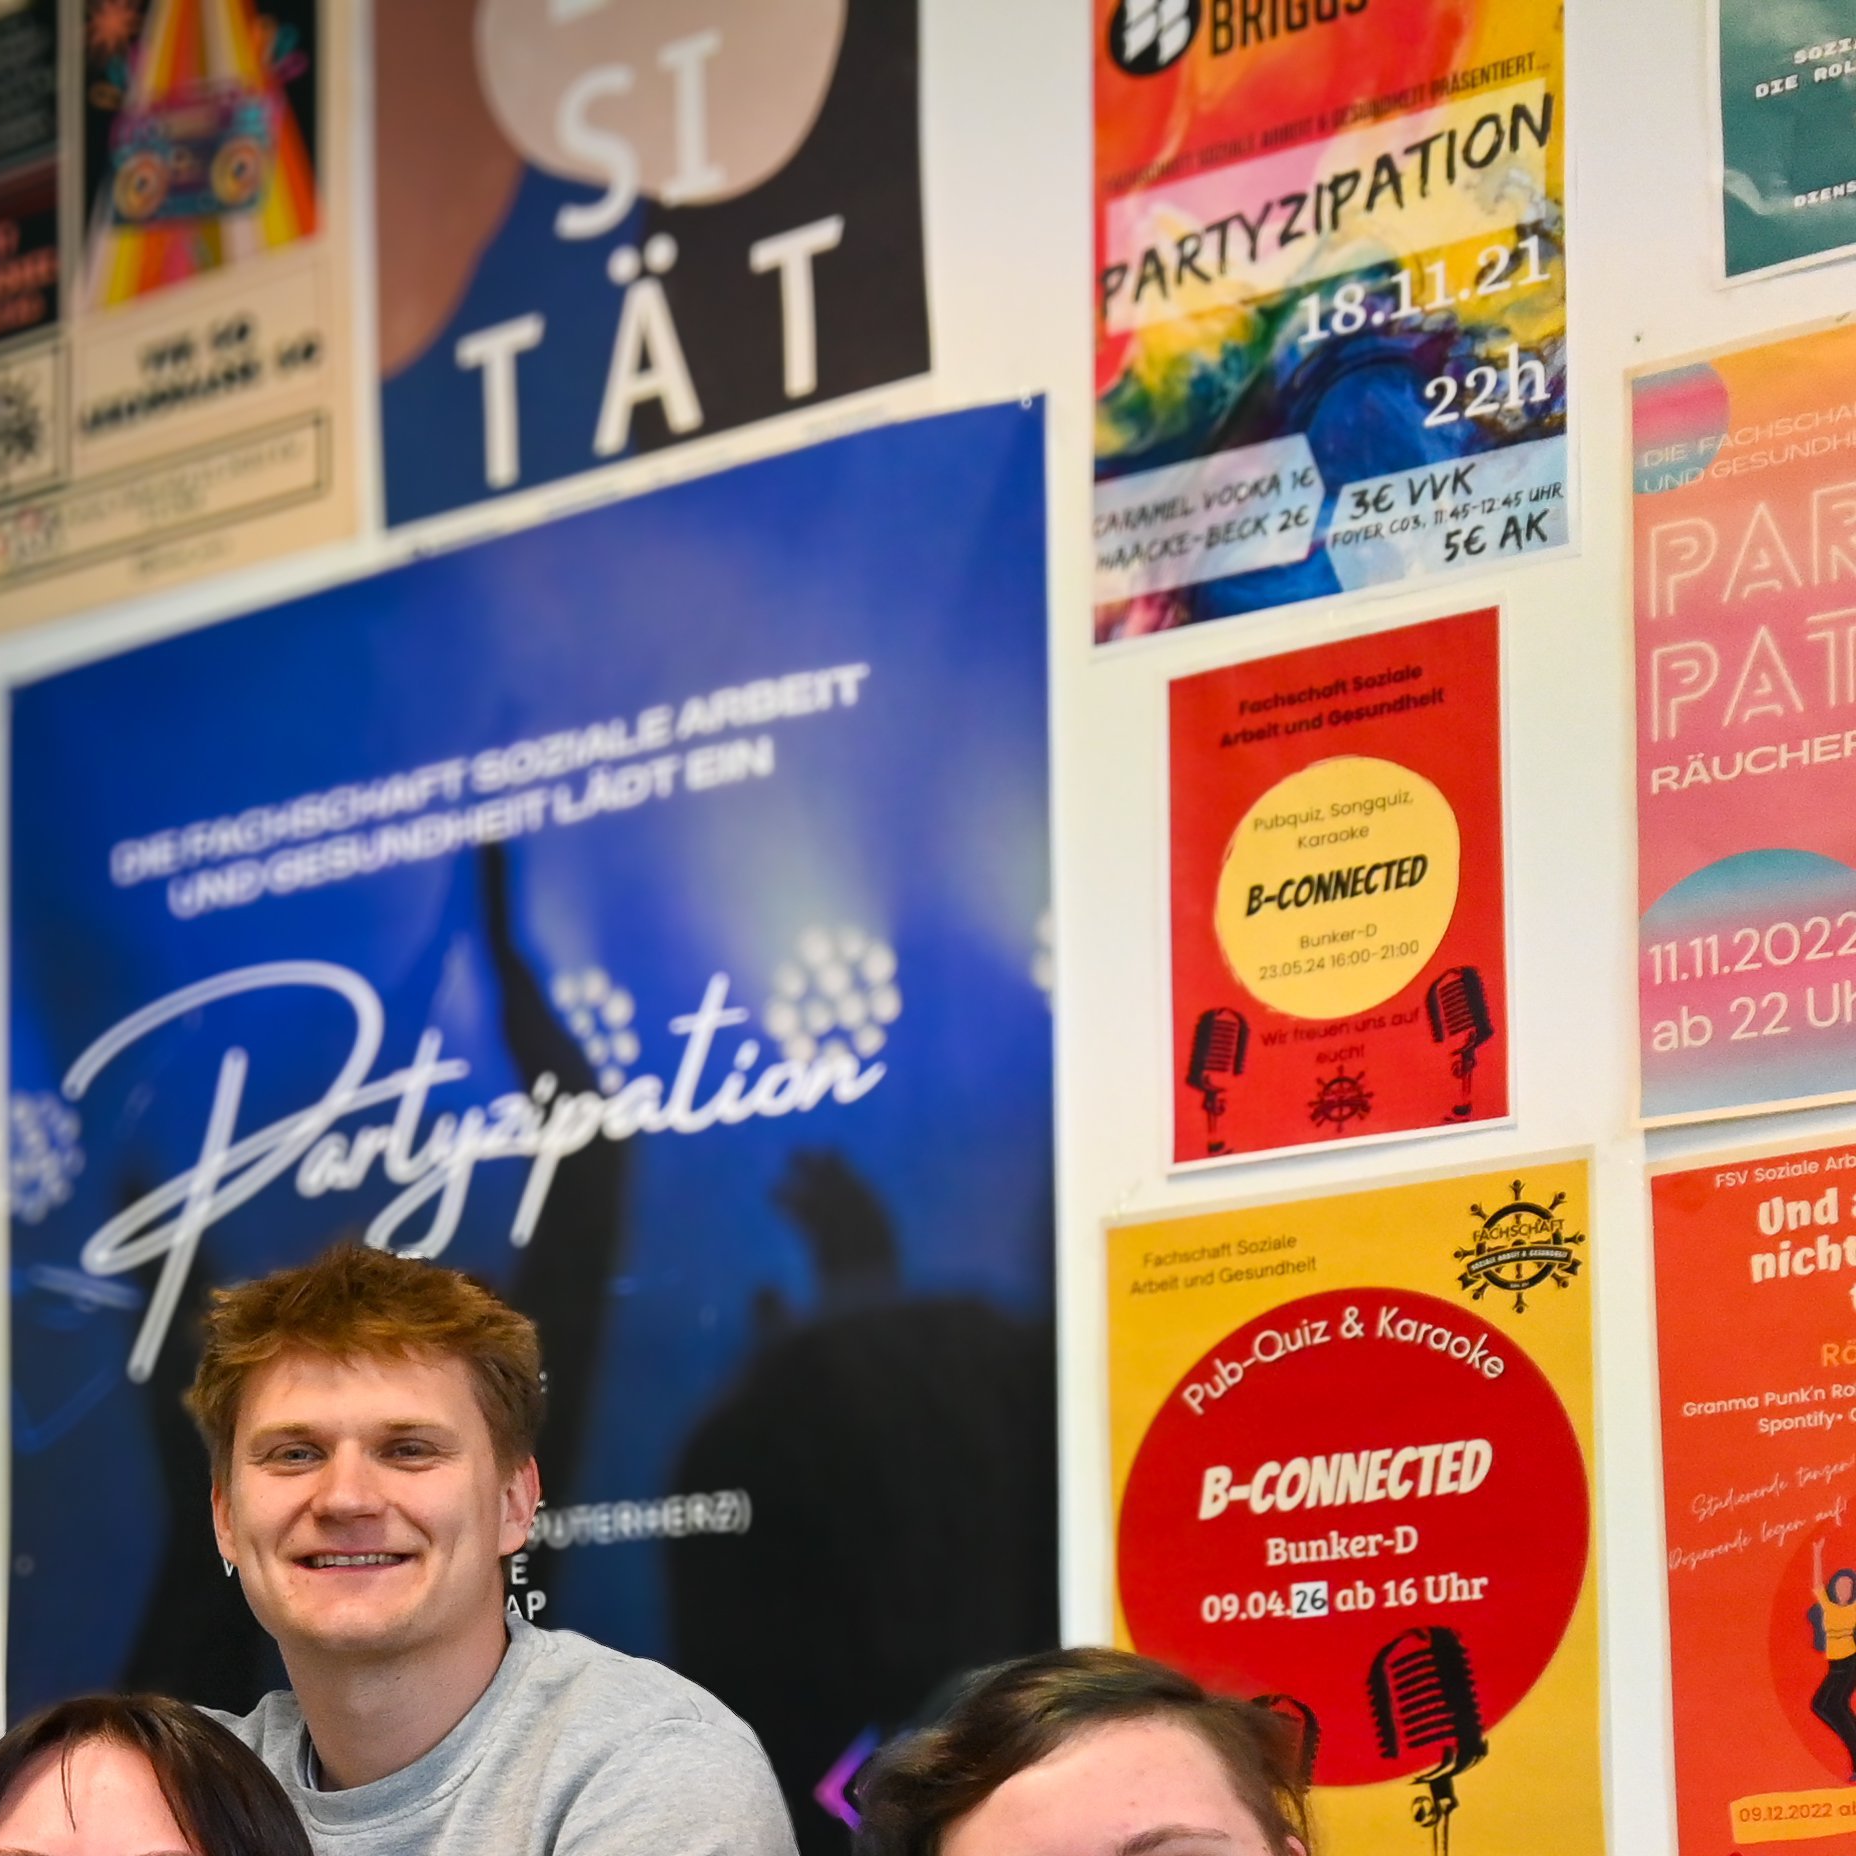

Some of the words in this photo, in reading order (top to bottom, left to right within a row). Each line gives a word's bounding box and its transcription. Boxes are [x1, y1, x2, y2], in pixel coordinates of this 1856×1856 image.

[1755, 73, 1800, 100] DIE
[1097, 90, 1558, 316] PARTYZIPATION
[1297, 233, 1551, 347] 18.11.21
[454, 213, 845, 491] TÄT
[1421, 341, 1552, 431] 22h
[1642, 441, 1690, 469] DIE
[1698, 401, 1856, 454] FACHSCHA
[1643, 465, 1706, 494] UND
[1710, 428, 1856, 480] GESUNDH
[1090, 495, 1195, 541] CARAMEL
[1201, 472, 1282, 513] VODKA
[1289, 464, 1316, 493] 1€
[1330, 522, 1386, 551] FOYER
[1527, 480, 1566, 505] UHR
[1348, 482, 1397, 521] 3€
[1406, 461, 1478, 508] VVK
[1277, 504, 1311, 533] 2€
[1442, 527, 1488, 564] 5€
[1499, 508, 1551, 551] AK
[1238, 678, 1349, 717] Fachschaft
[1351, 664, 1424, 693] Soziale
[1219, 722, 1281, 749] Arbeit
[1283, 712, 1325, 737] und
[1327, 686, 1446, 728] Gesundheit
[108, 826, 184, 888] DIE
[180, 755, 470, 864] FACHSCHAFT
[469, 702, 675, 794] SOZIALE
[675, 661, 872, 742] ARBEIT
[166, 857, 267, 921] UND
[261, 786, 550, 895] GESUNDHEIT
[551, 753, 683, 827] LÄDT
[682, 732, 776, 793] EIN
[1329, 788, 1415, 818] Songquiz,
[1296, 824, 1371, 851] Karaoke
[1245, 853, 1429, 918] B-CONNECTED
[1259, 956, 1326, 982] 23.05.24
[1329, 938, 1421, 970] 16:00-21:00
[1299, 922, 1378, 950] Bunker-D
[1647, 910, 1856, 986] 11.11.2022
[1260, 1028, 1290, 1048] Wir
[1293, 1021, 1351, 1043] freuen
[1354, 1016, 1386, 1033] uns
[1390, 1006, 1421, 1027] auf
[1651, 1005, 1714, 1052] ab
[1729, 991, 1792, 1041] 22
[1315, 1043, 1366, 1065] euch!
[59, 958, 888, 1384] Partyzipation
[1714, 1168, 1750, 1189] FSV
[1753, 1159, 1820, 1183] Soziale
[1472, 1218, 1565, 1243] FACHSCHAFT
[1757, 1186, 1840, 1237] Und
[1130, 1276, 1180, 1296] Arbeit
[1183, 1269, 1215, 1288] und
[1218, 1255, 1318, 1284] Gesundheit
[1142, 1242, 1232, 1268] Fachschaft
[1237, 1233, 1298, 1257] Soziale
[1181, 1318, 1331, 1416] Pub-Quiz
[1339, 1304, 1365, 1339] &
[1377, 1305, 1506, 1381] Karaoke
[1682, 1394, 1761, 1418] Granma
[1197, 1437, 1494, 1521] B-CONNECTED
[1691, 1471, 1790, 1524] Studierende
[1265, 1525, 1420, 1567] Bunker-D
[1761, 1518, 1807, 1547] legen
[1334, 1579, 1376, 1612] ab
[1382, 1577, 1418, 1609] 16
[1423, 1571, 1490, 1605] Uhr
[1739, 1802, 1834, 1823] 09.12.2022
